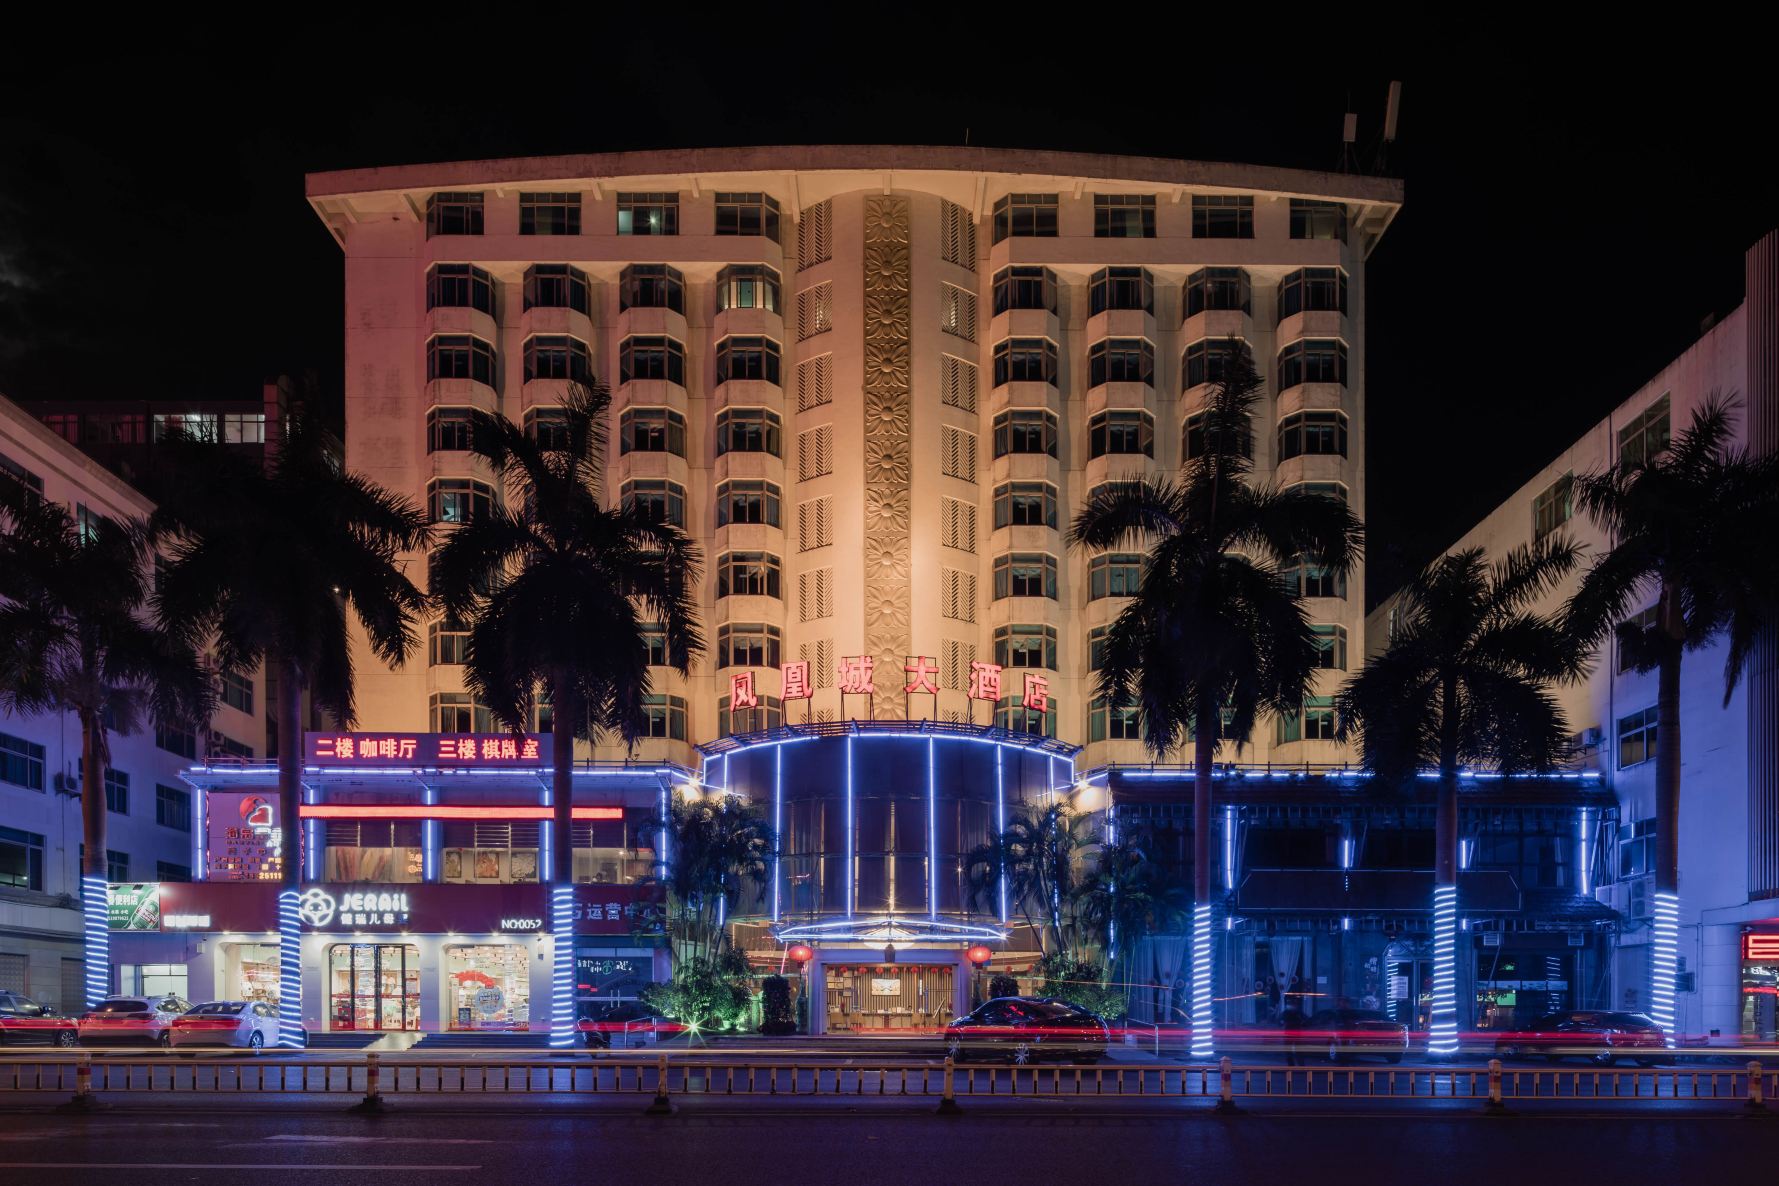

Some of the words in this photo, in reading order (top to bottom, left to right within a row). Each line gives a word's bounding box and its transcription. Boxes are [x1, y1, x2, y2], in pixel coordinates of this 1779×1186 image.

[731, 655, 1048, 713] 凤凰城大酒店
[316, 738, 354, 759] 二楼
[359, 738, 417, 759] 咖啡厅
[438, 739, 476, 759] 三楼
[482, 739, 540, 759] 棋牌室
